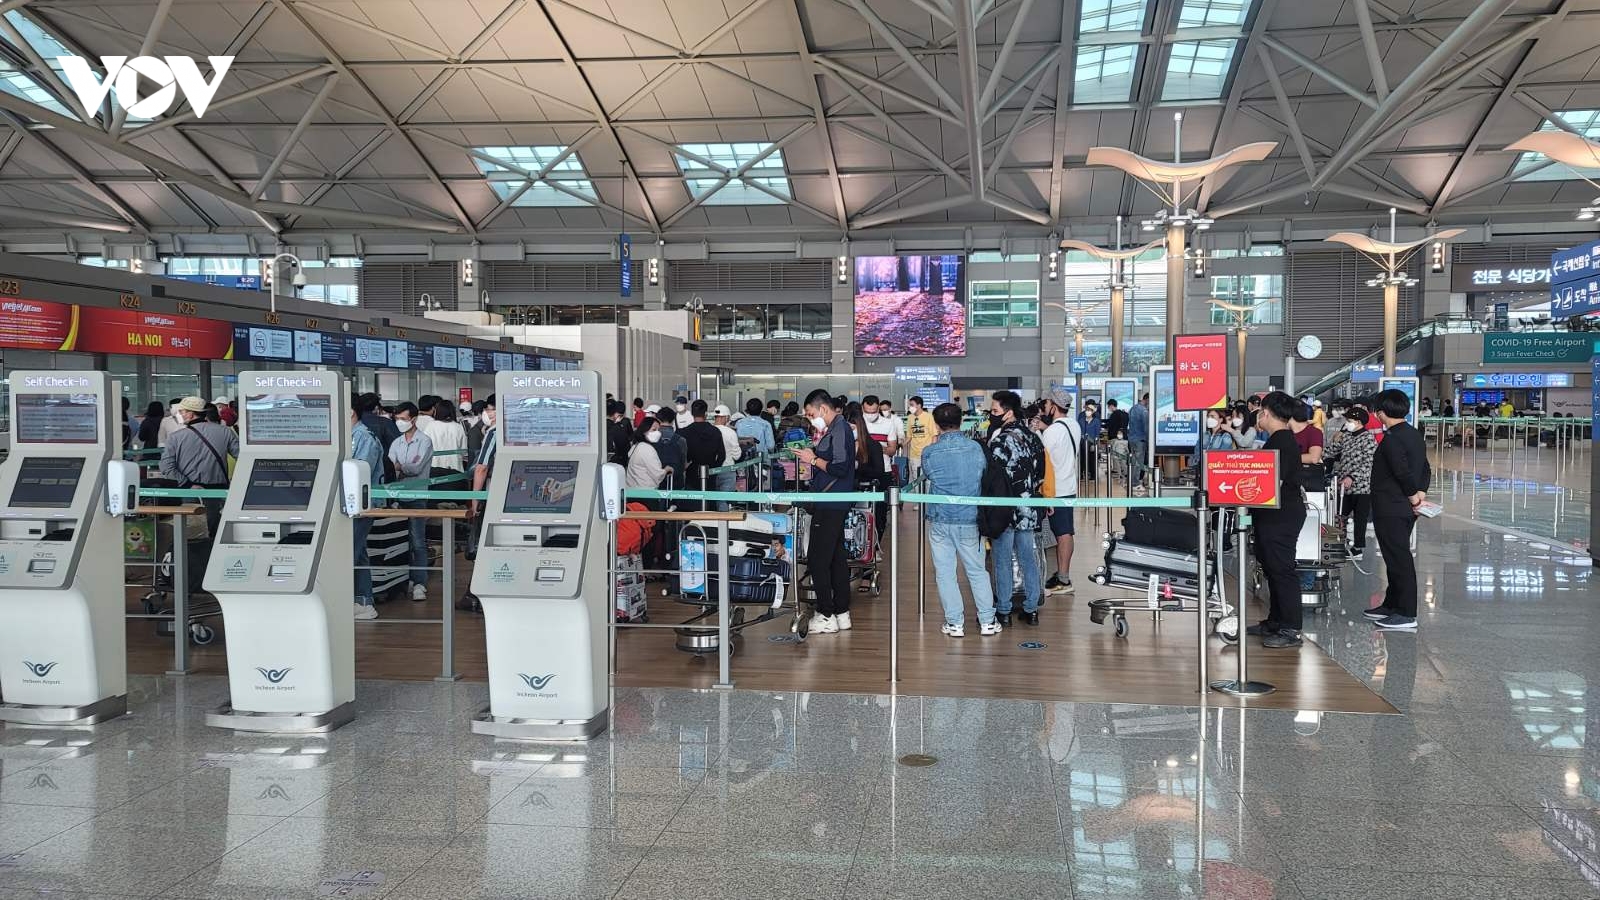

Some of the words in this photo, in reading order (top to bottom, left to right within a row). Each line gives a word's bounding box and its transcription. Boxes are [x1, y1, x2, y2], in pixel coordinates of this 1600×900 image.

[623, 242, 629, 257] 5
[1472, 269, 1503, 285] 전문
[1507, 268, 1552, 284] 식당가
[120, 294, 141, 308] K24
[1574, 288, 1587, 303] 도착
[177, 302, 196, 315] K25
[127, 332, 142, 346] HA
[144, 334, 162, 347] NOI
[171, 337, 191, 349] 하노이
[1491, 338, 1532, 347] COVID-19
[1534, 338, 1553, 347] Free
[1555, 338, 1585, 349] Airport
[24, 377, 43, 387] Self
[45, 377, 89, 387] Check-In
[255, 377, 275, 387] Self
[276, 377, 322, 387] Check-In
[512, 377, 532, 388] Self
[534, 377, 581, 388] Check-In
[1180, 377, 1190, 385] HA
[1490, 374, 1542, 387] 우리은행
